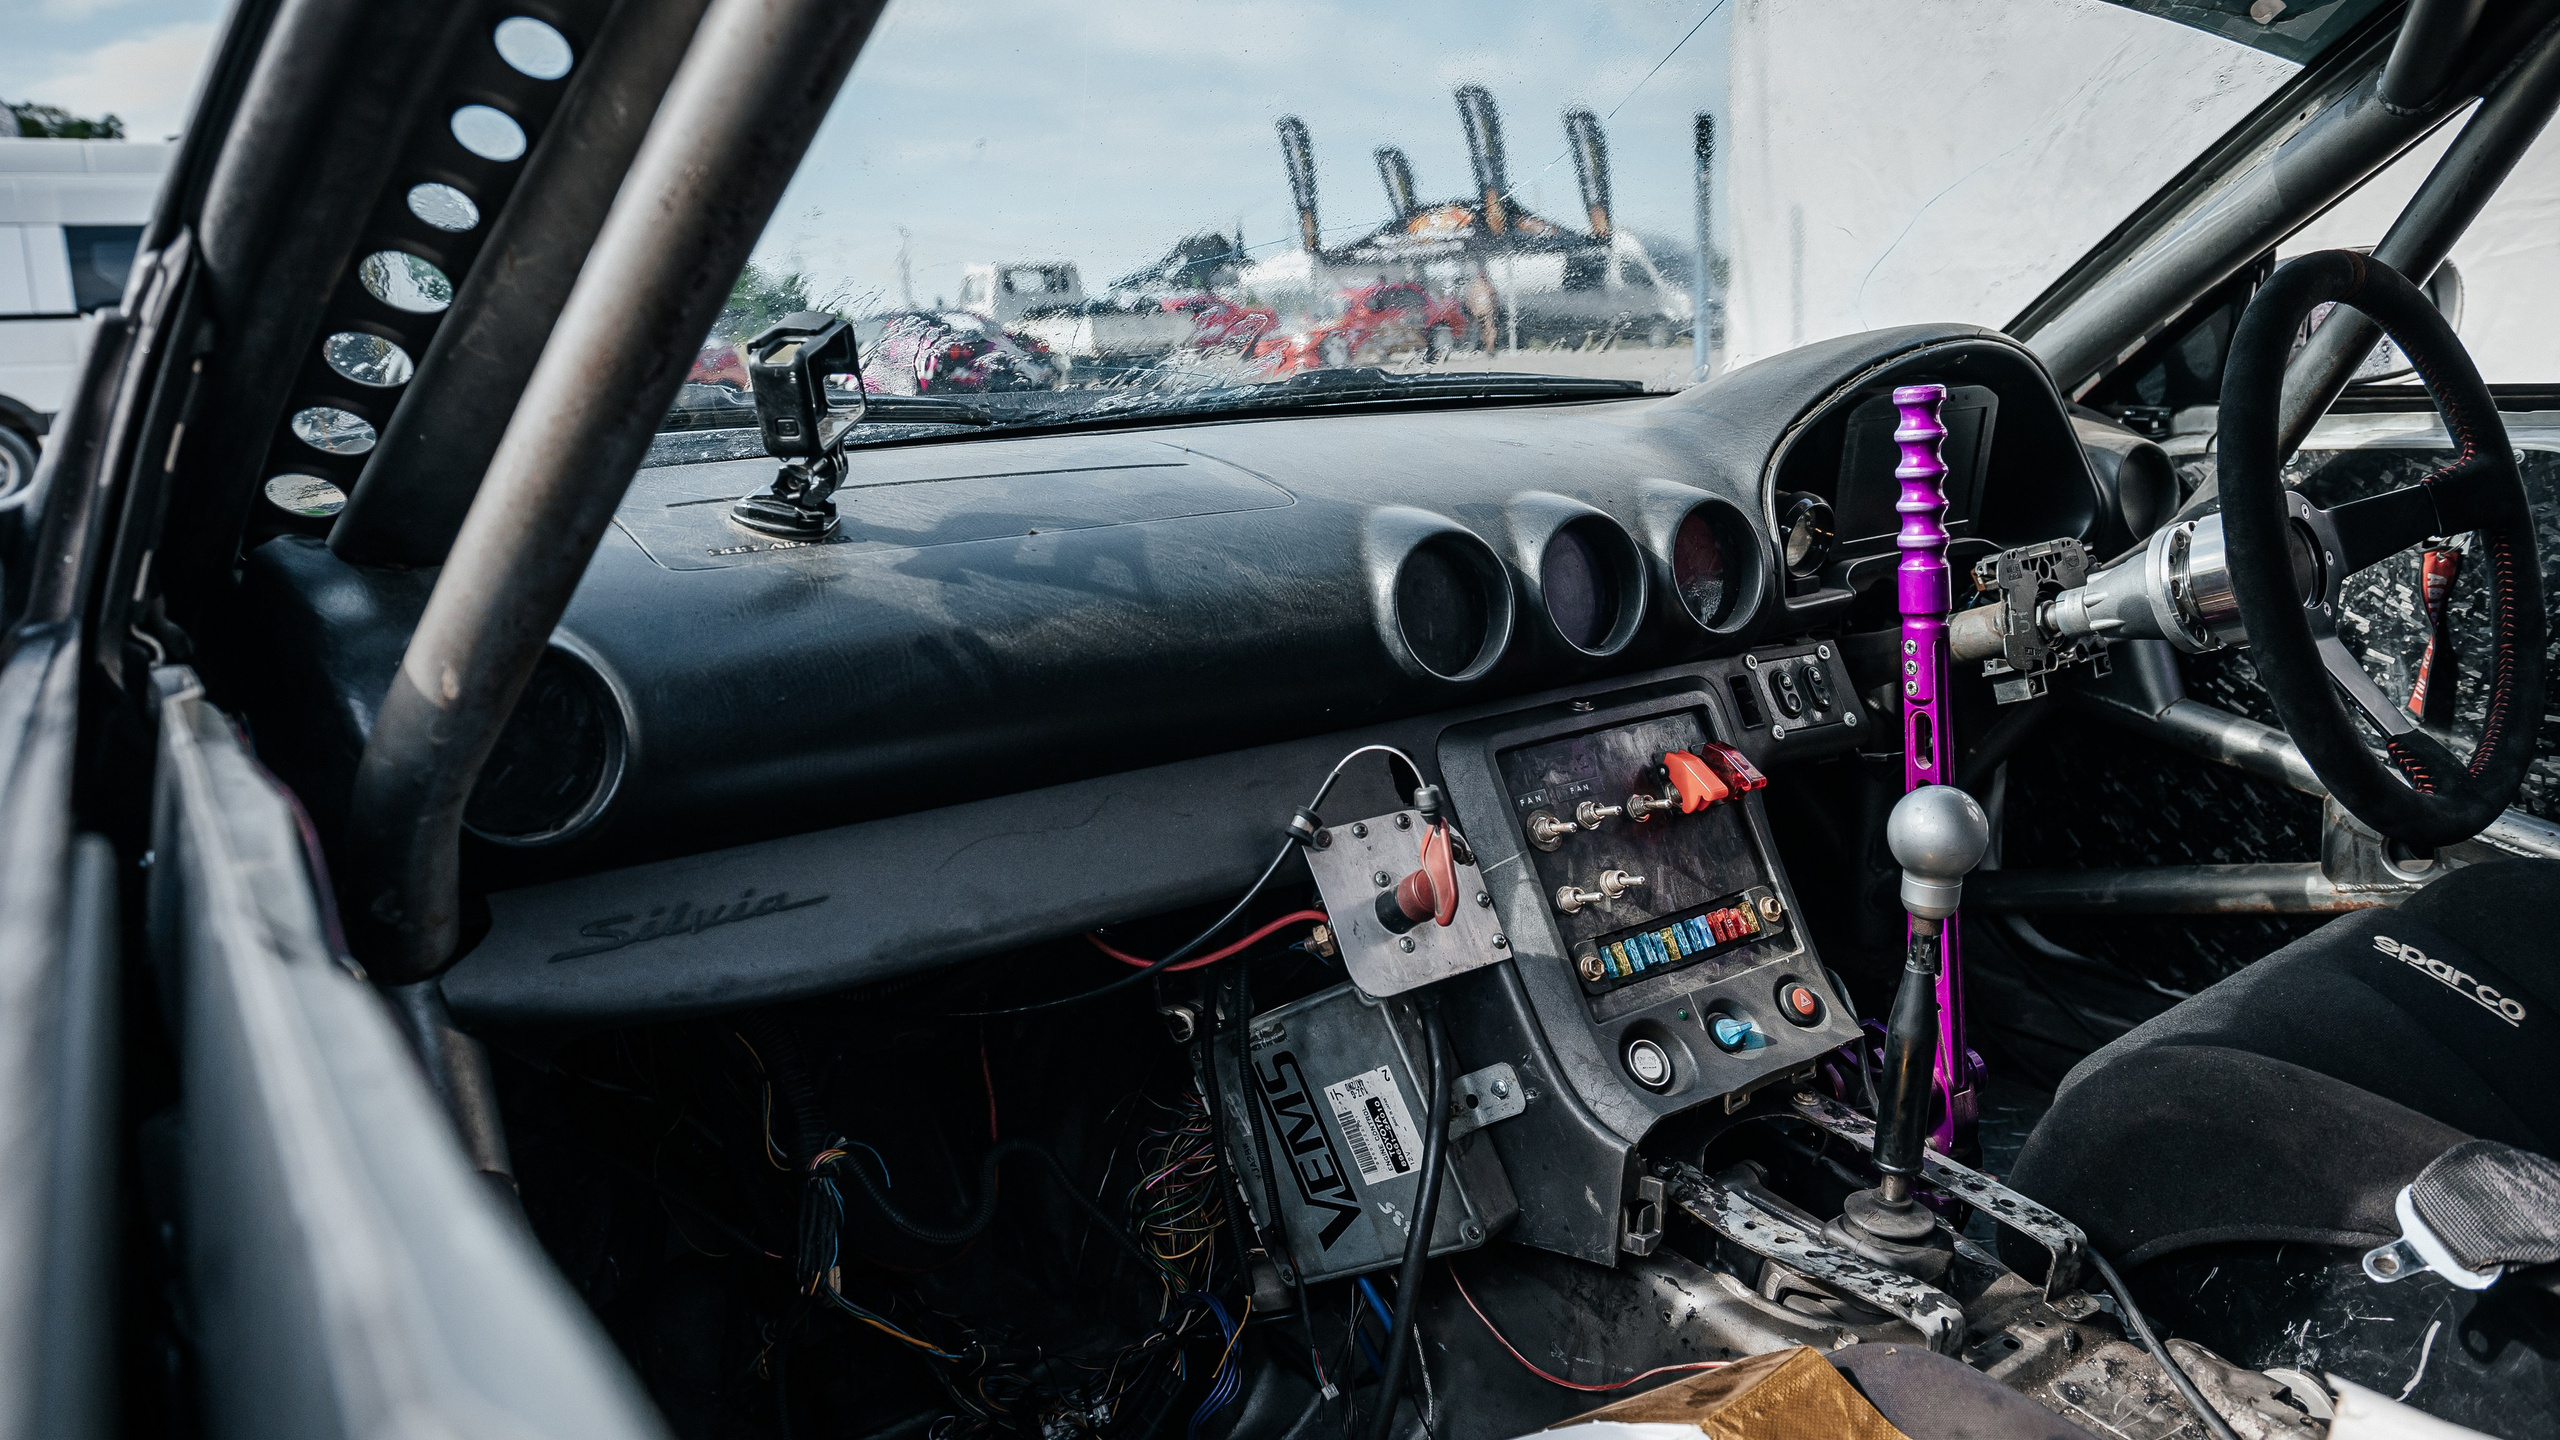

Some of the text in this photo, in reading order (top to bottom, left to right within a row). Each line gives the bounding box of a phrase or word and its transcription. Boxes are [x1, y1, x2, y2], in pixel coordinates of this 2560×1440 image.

[1519, 794, 1542, 806] FAN
[1569, 783, 1590, 794] FAN
[549, 889, 829, 962] Silvia
[2373, 935, 2526, 1022] sparco
[1382, 1069, 1391, 1082] 2
[1255, 1051, 1361, 1252] VEMS
[1361, 1105, 1393, 1171] ENGINE CONTROL
[1374, 1115, 1396, 1157] TOYOTA
